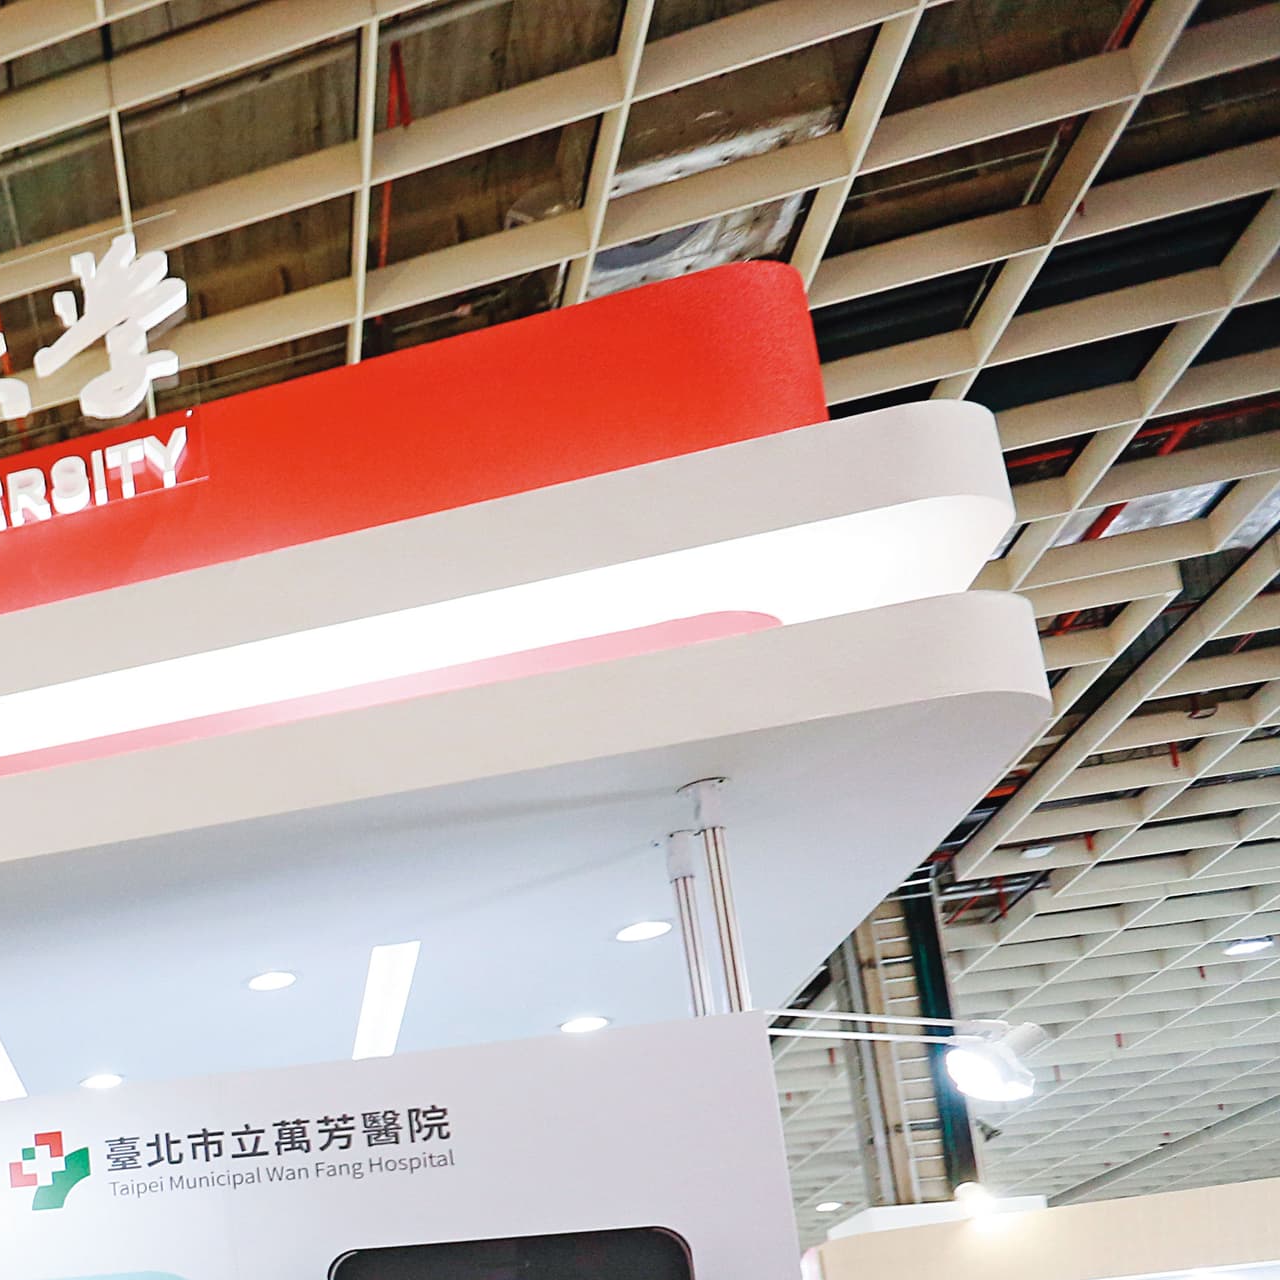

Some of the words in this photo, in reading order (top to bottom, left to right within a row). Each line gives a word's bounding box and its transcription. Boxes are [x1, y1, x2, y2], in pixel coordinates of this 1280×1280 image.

[105, 1103, 452, 1172] 臺北市立萬芳醫院
[109, 1180, 164, 1198] Taipei
[170, 1167, 262, 1191] Municipal
[267, 1165, 310, 1183] Wan
[316, 1160, 364, 1180] Fang
[369, 1149, 456, 1176] Hospital
